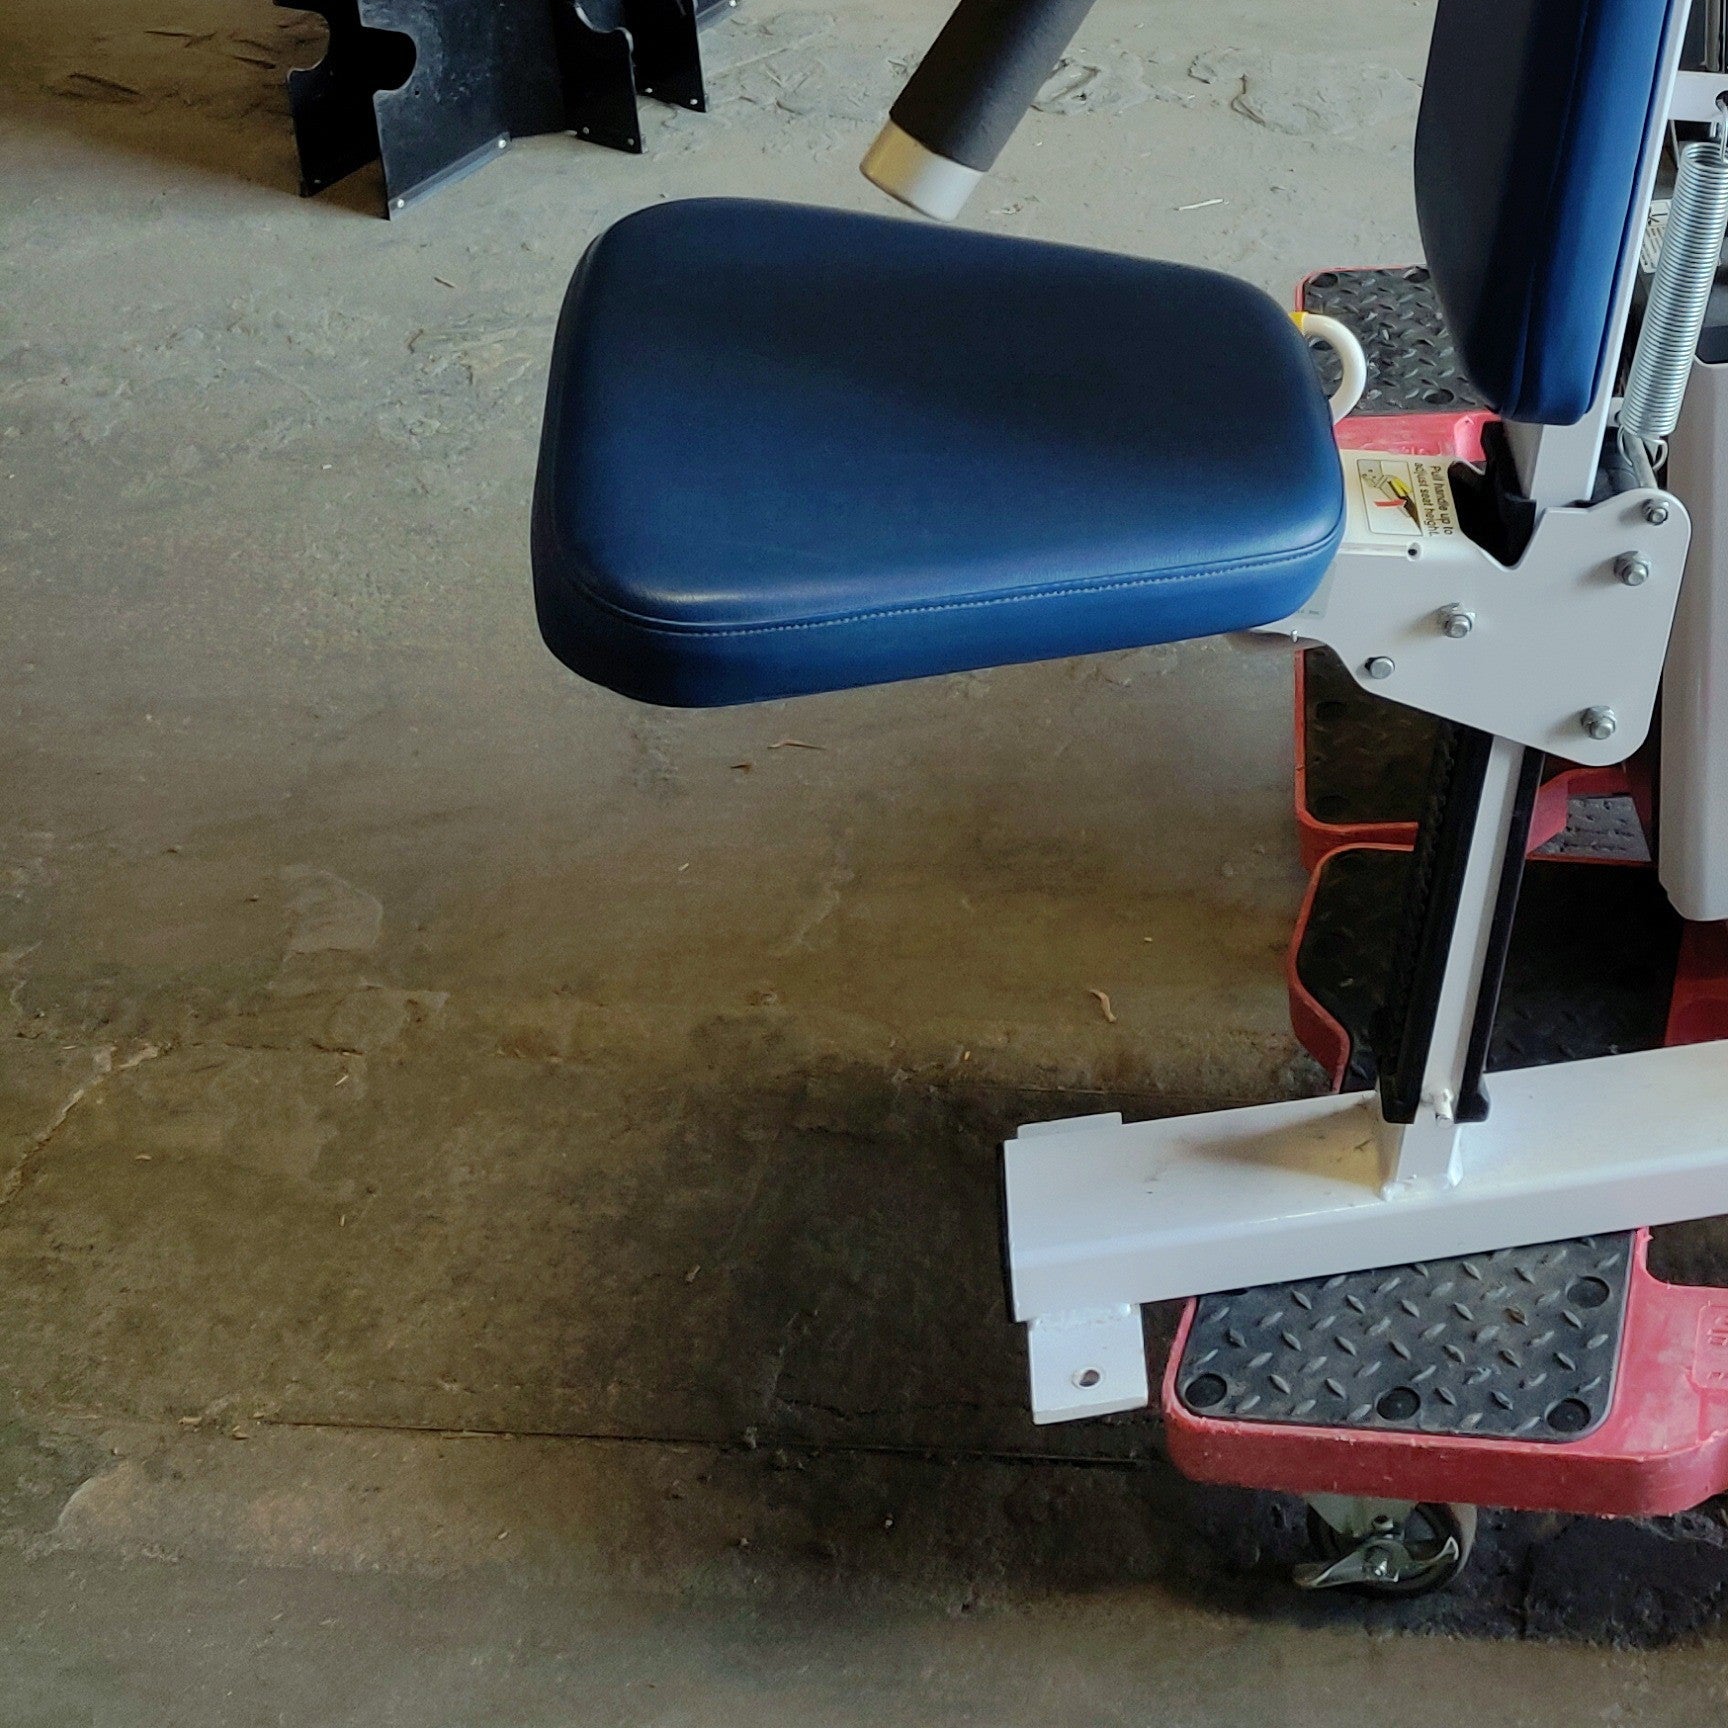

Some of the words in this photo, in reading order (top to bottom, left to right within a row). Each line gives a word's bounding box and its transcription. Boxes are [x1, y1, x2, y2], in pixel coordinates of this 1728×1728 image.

[1413, 462, 1428, 487] adjust
[1430, 465, 1444, 481] Pull
[1420, 489, 1434, 507] seat
[1433, 483, 1449, 512] handle
[1437, 513, 1452, 525] up
[1443, 526, 1453, 536] to
